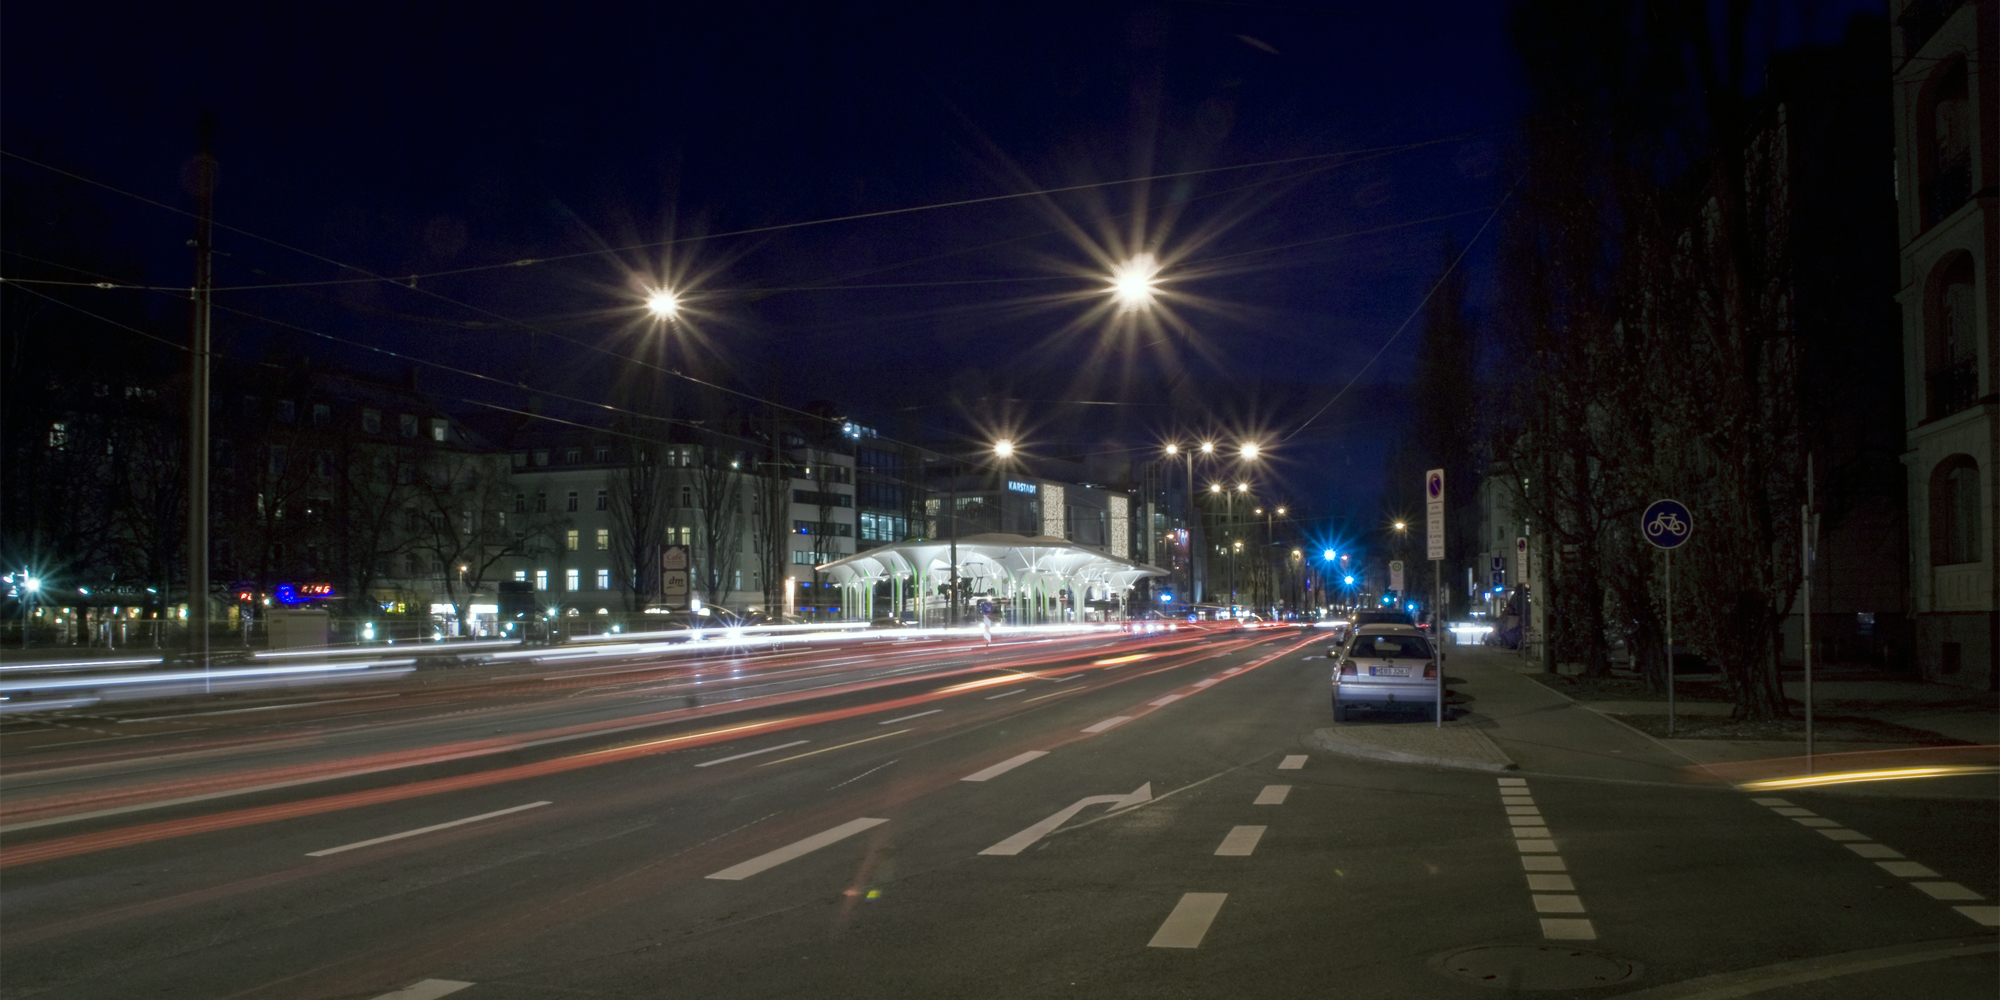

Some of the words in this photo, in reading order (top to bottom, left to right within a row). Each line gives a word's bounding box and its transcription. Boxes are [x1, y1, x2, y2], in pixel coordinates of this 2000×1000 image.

[1008, 480, 1036, 494] KARSTADT
[1492, 558, 1502, 570] U
[669, 576, 683, 585] dm
